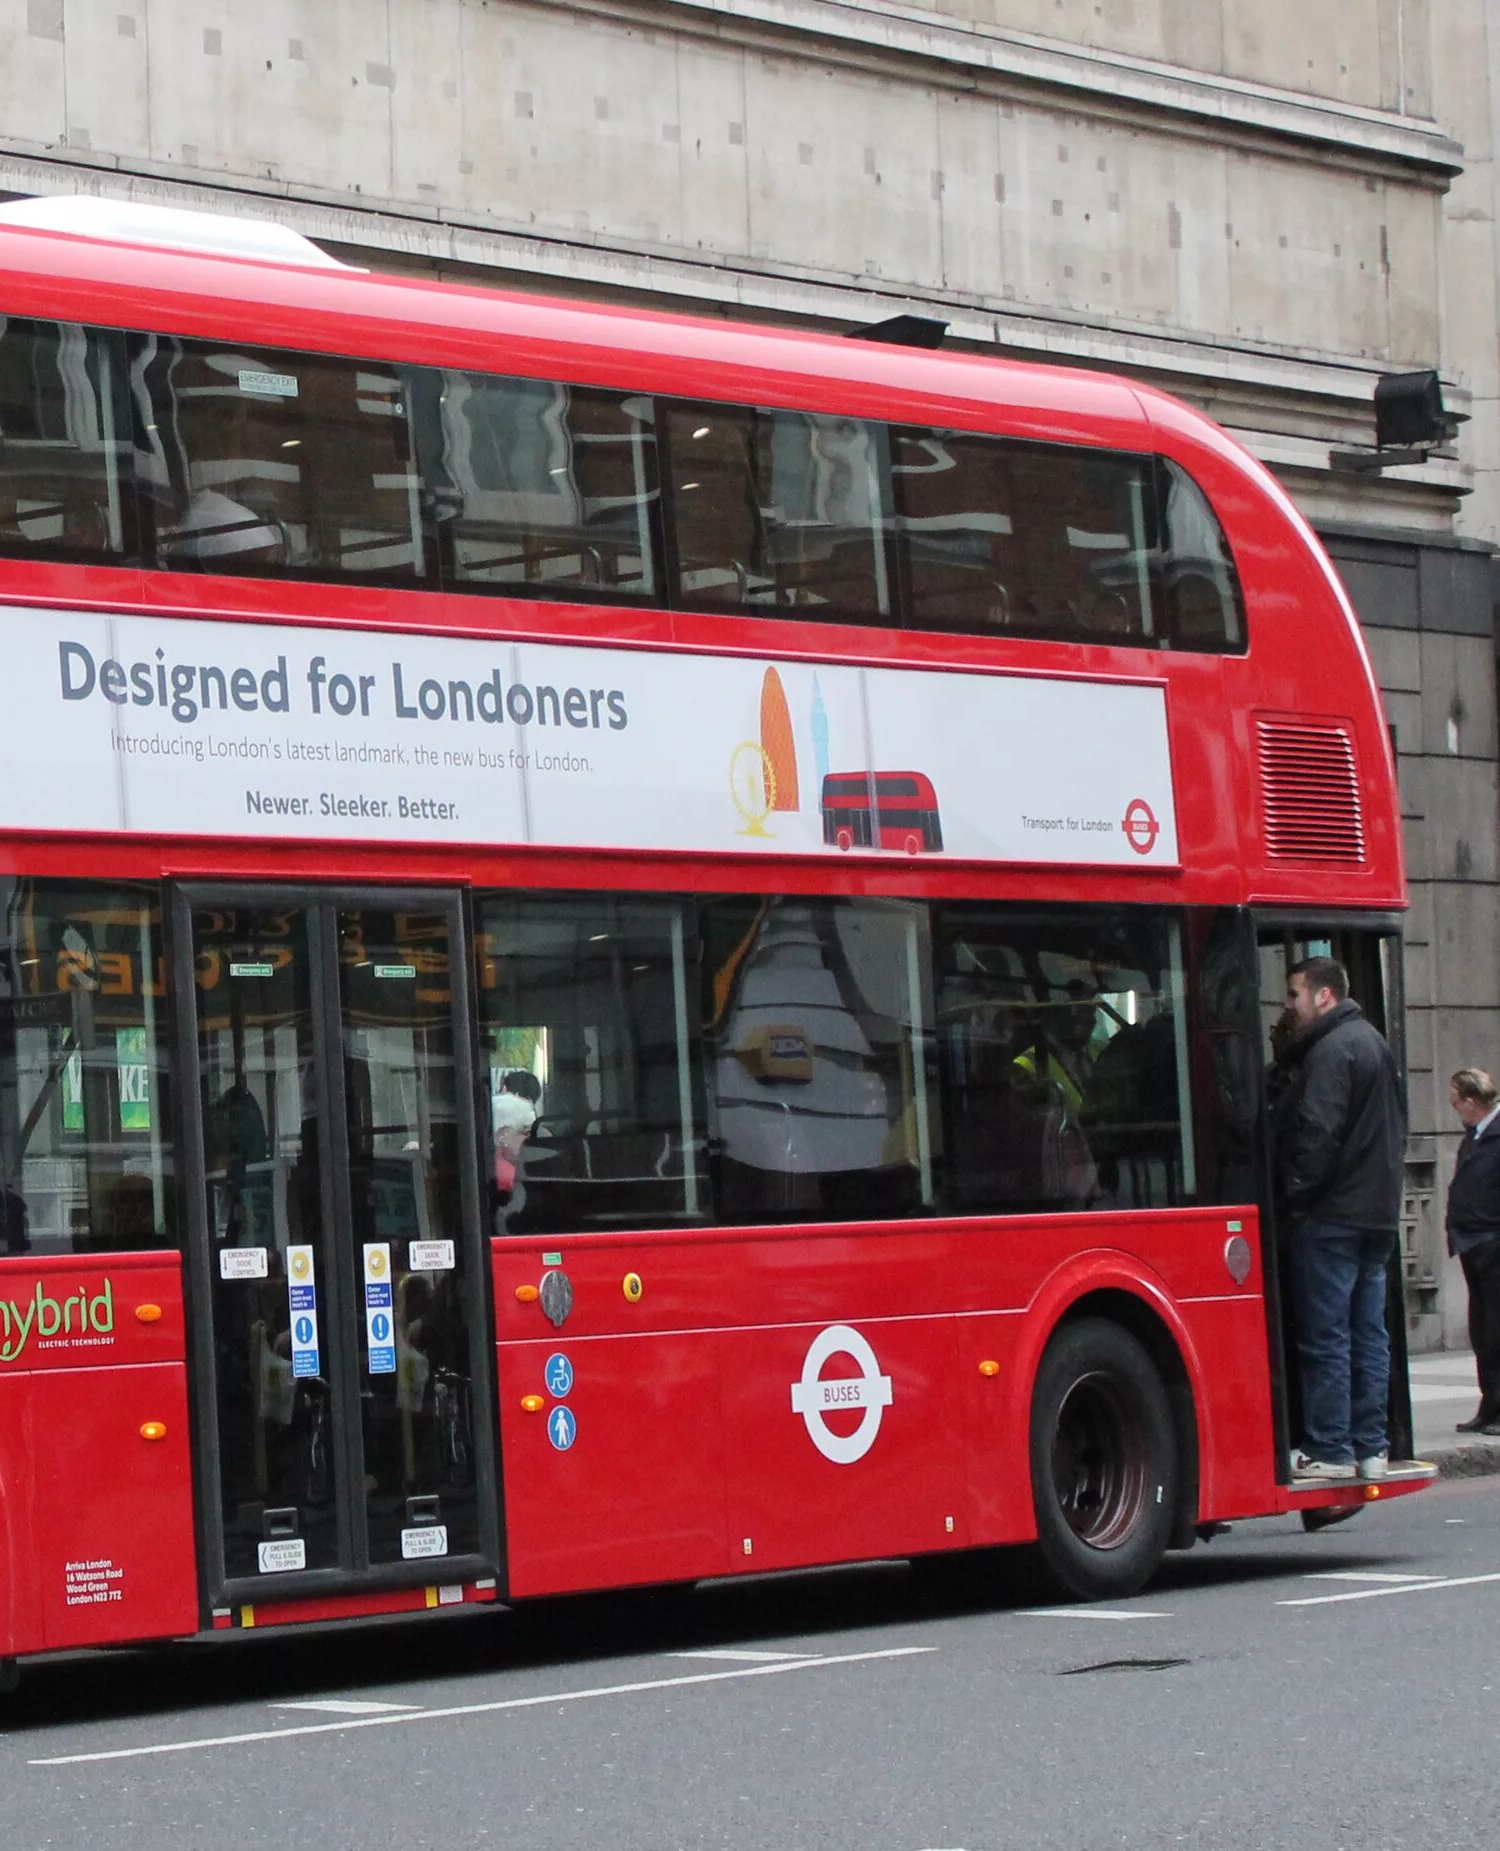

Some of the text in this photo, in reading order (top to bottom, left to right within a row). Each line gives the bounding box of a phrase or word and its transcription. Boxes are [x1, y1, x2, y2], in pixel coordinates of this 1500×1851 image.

[58, 640, 629, 731] Designed for Londoners
[111, 728, 594, 772] Introducing London's latest landmark, the new bus for London.
[246, 791, 459, 820] Newer. Sleeker. Better.
[1021, 816, 1113, 832] Transport for London
[38, 1337, 115, 1349] ELECTRIC TECHNOLOGY
[823, 1385, 860, 1403] BUSES
[66, 1559, 112, 1571] Arriva London
[67, 1568, 123, 1582] 16 Watsons Road
[66, 1582, 109, 1593] Wood Green
[67, 1594, 92, 1605] London
[93, 1592, 107, 1602] N22
